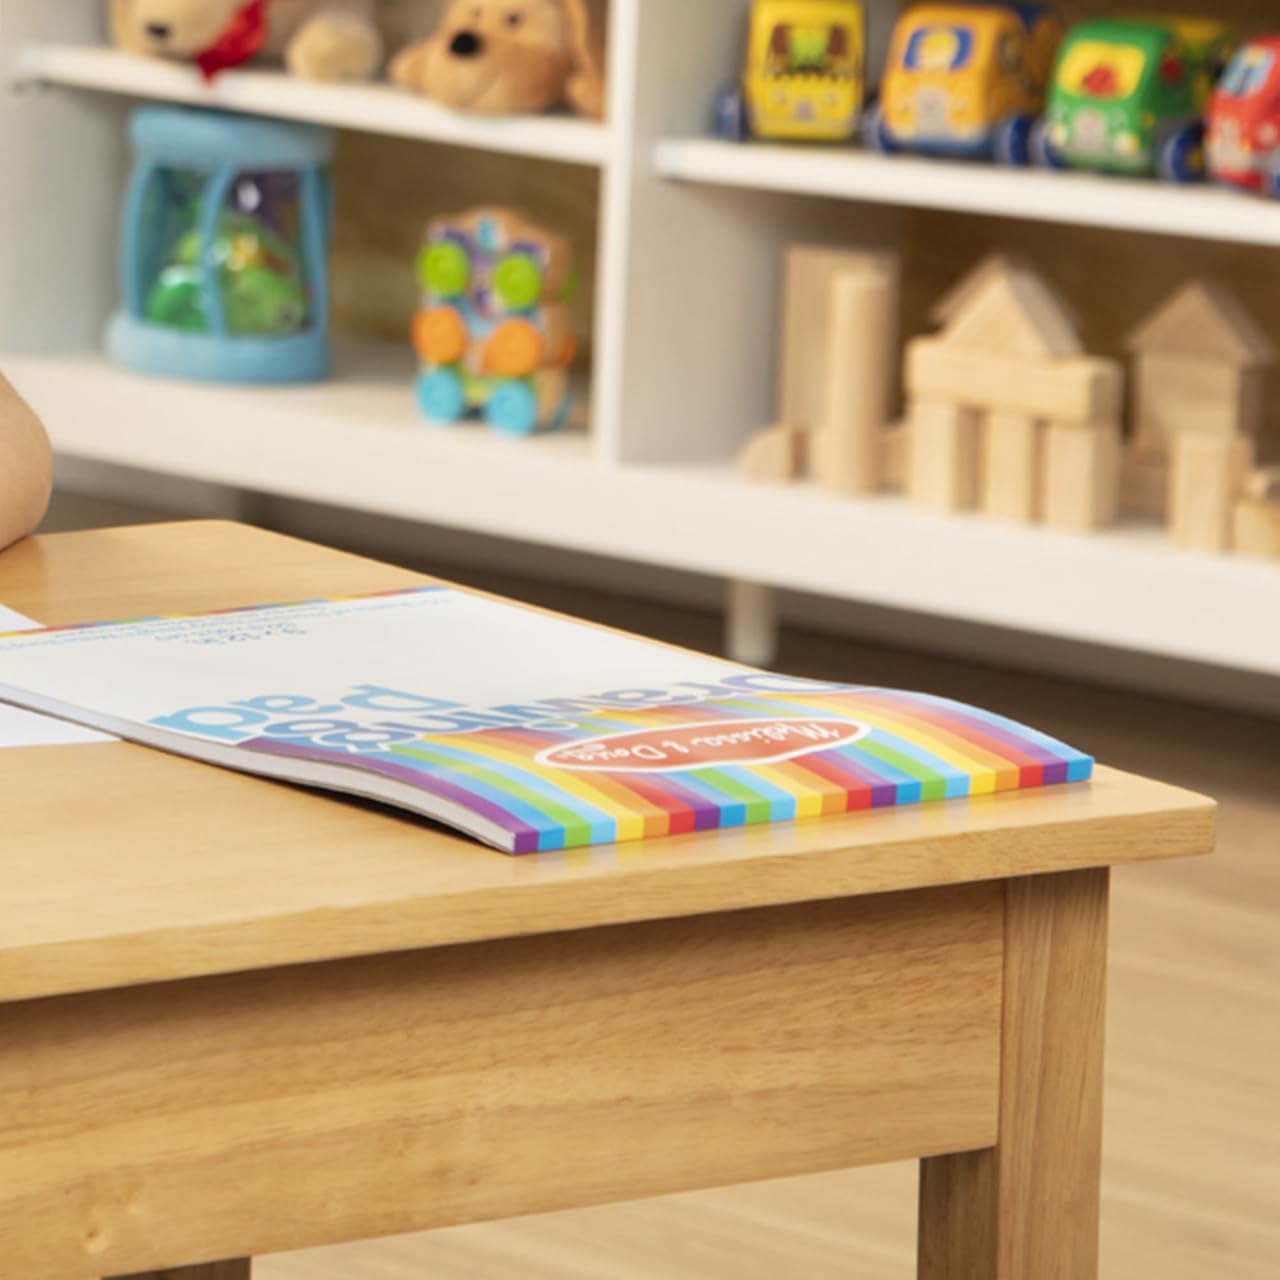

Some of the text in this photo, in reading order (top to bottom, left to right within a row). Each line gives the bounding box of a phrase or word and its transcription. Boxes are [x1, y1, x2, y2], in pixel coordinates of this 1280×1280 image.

[146, 684, 468, 742] Pad
[263, 674, 868, 751] Drawing
[556, 742, 668, 760] Doug
[691, 722, 842, 747] Melissa
